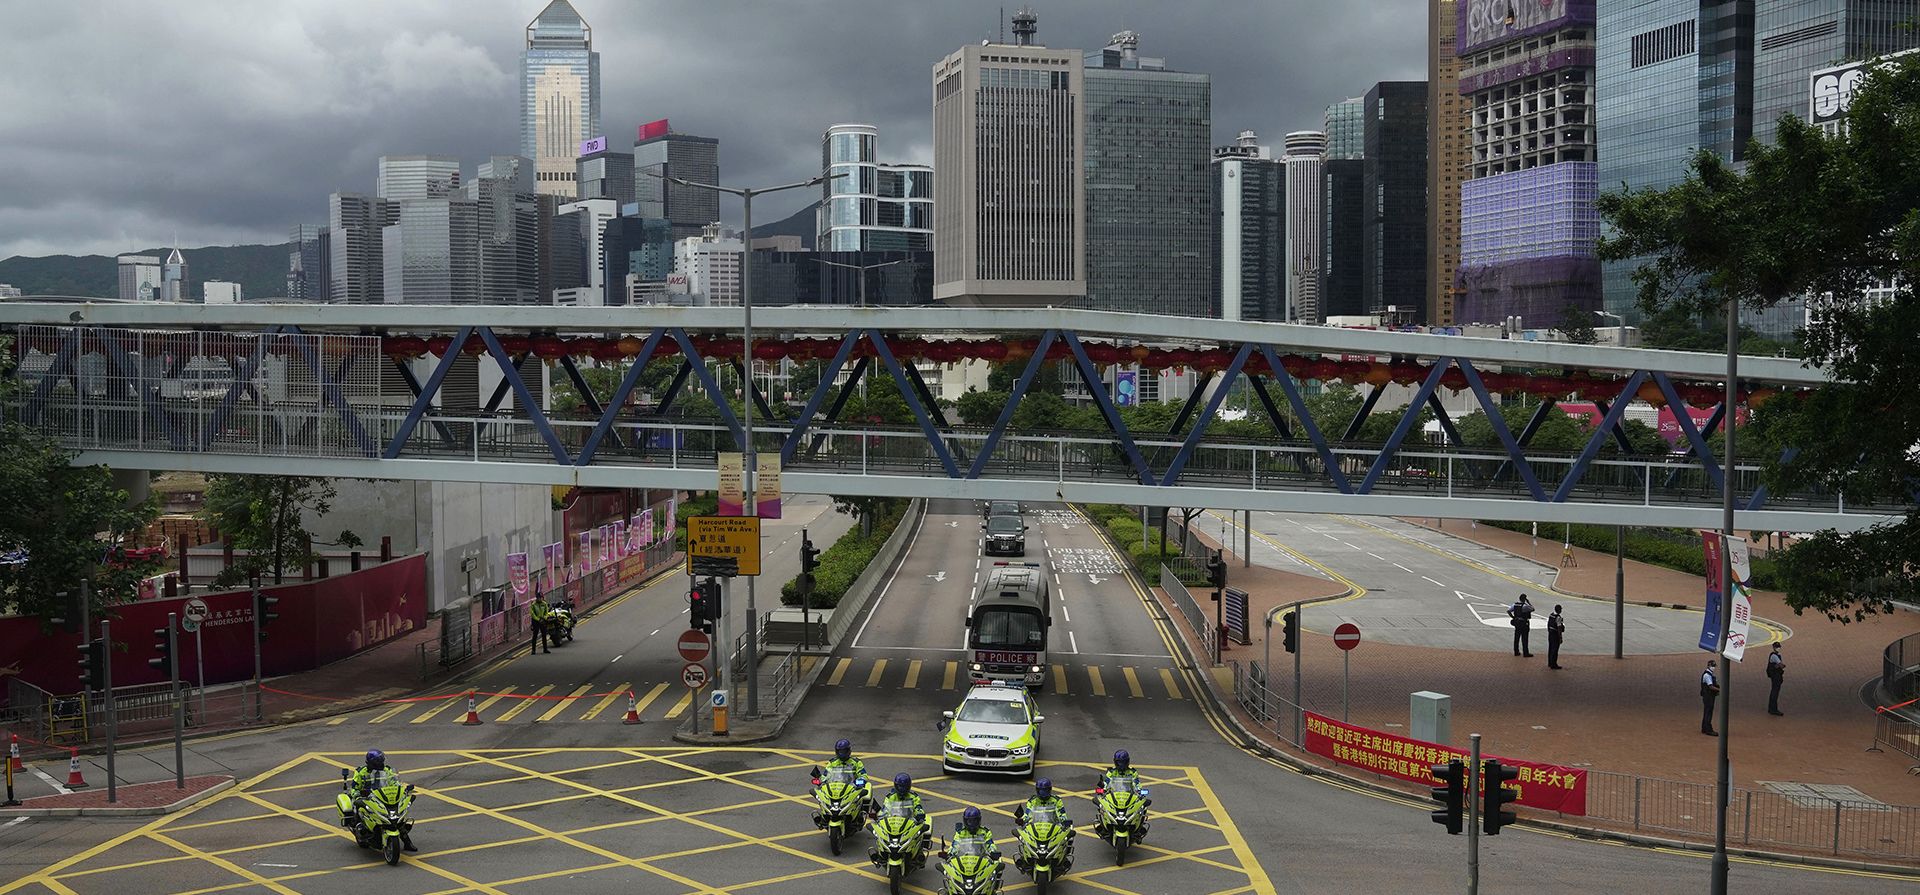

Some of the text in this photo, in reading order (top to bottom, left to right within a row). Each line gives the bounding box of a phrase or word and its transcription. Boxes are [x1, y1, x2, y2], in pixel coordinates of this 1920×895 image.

[587, 140, 599, 151] FWD
[205, 616, 244, 627] HENDERSON
[990, 653, 1023, 663] POLICE
